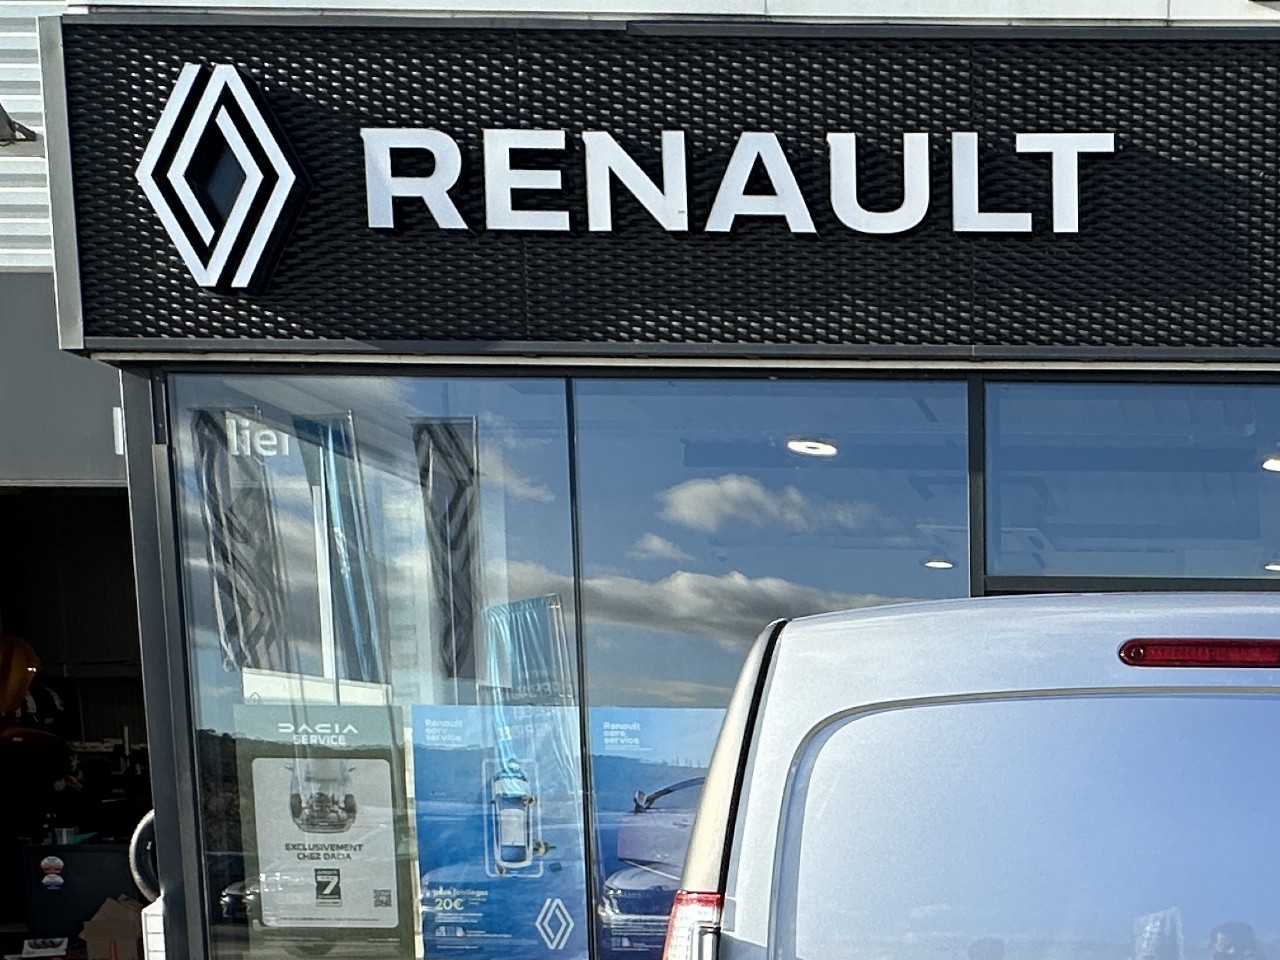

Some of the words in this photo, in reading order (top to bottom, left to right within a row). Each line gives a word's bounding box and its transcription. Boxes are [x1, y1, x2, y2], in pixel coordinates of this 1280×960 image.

[359, 127, 1116, 234] RENAULT
[277, 722, 359, 734] DACIA
[603, 721, 641, 730] Renault
[292, 734, 347, 745] SERVICE
[603, 737, 641, 745] service
[284, 842, 364, 852] EXCLUSIVEMENT
[296, 852, 321, 861] CHEZ
[323, 853, 352, 861] DACIA
[434, 898, 464, 911] 20€
